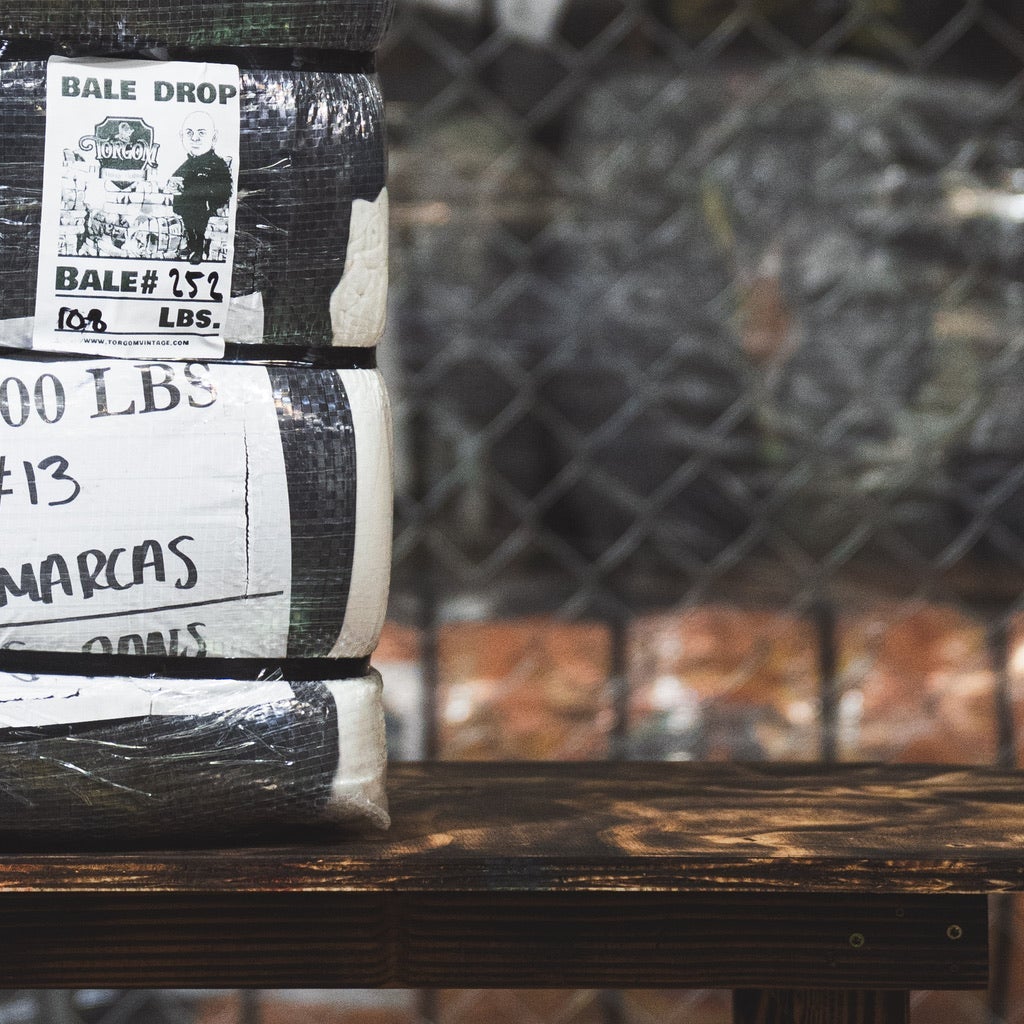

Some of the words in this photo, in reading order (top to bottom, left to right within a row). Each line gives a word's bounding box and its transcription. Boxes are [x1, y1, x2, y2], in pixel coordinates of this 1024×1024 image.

[61, 76, 137, 101] BALE
[154, 80, 237, 105] DROP
[79, 135, 160, 169] TORGOM
[55, 266, 158, 294] BALE#
[168, 268, 223, 302] 252
[158, 307, 221, 329] LBS.
[83, 337, 189, 346] WWW.TORGOMVINTAGE.COM
[86, 362, 218, 418] LBS
